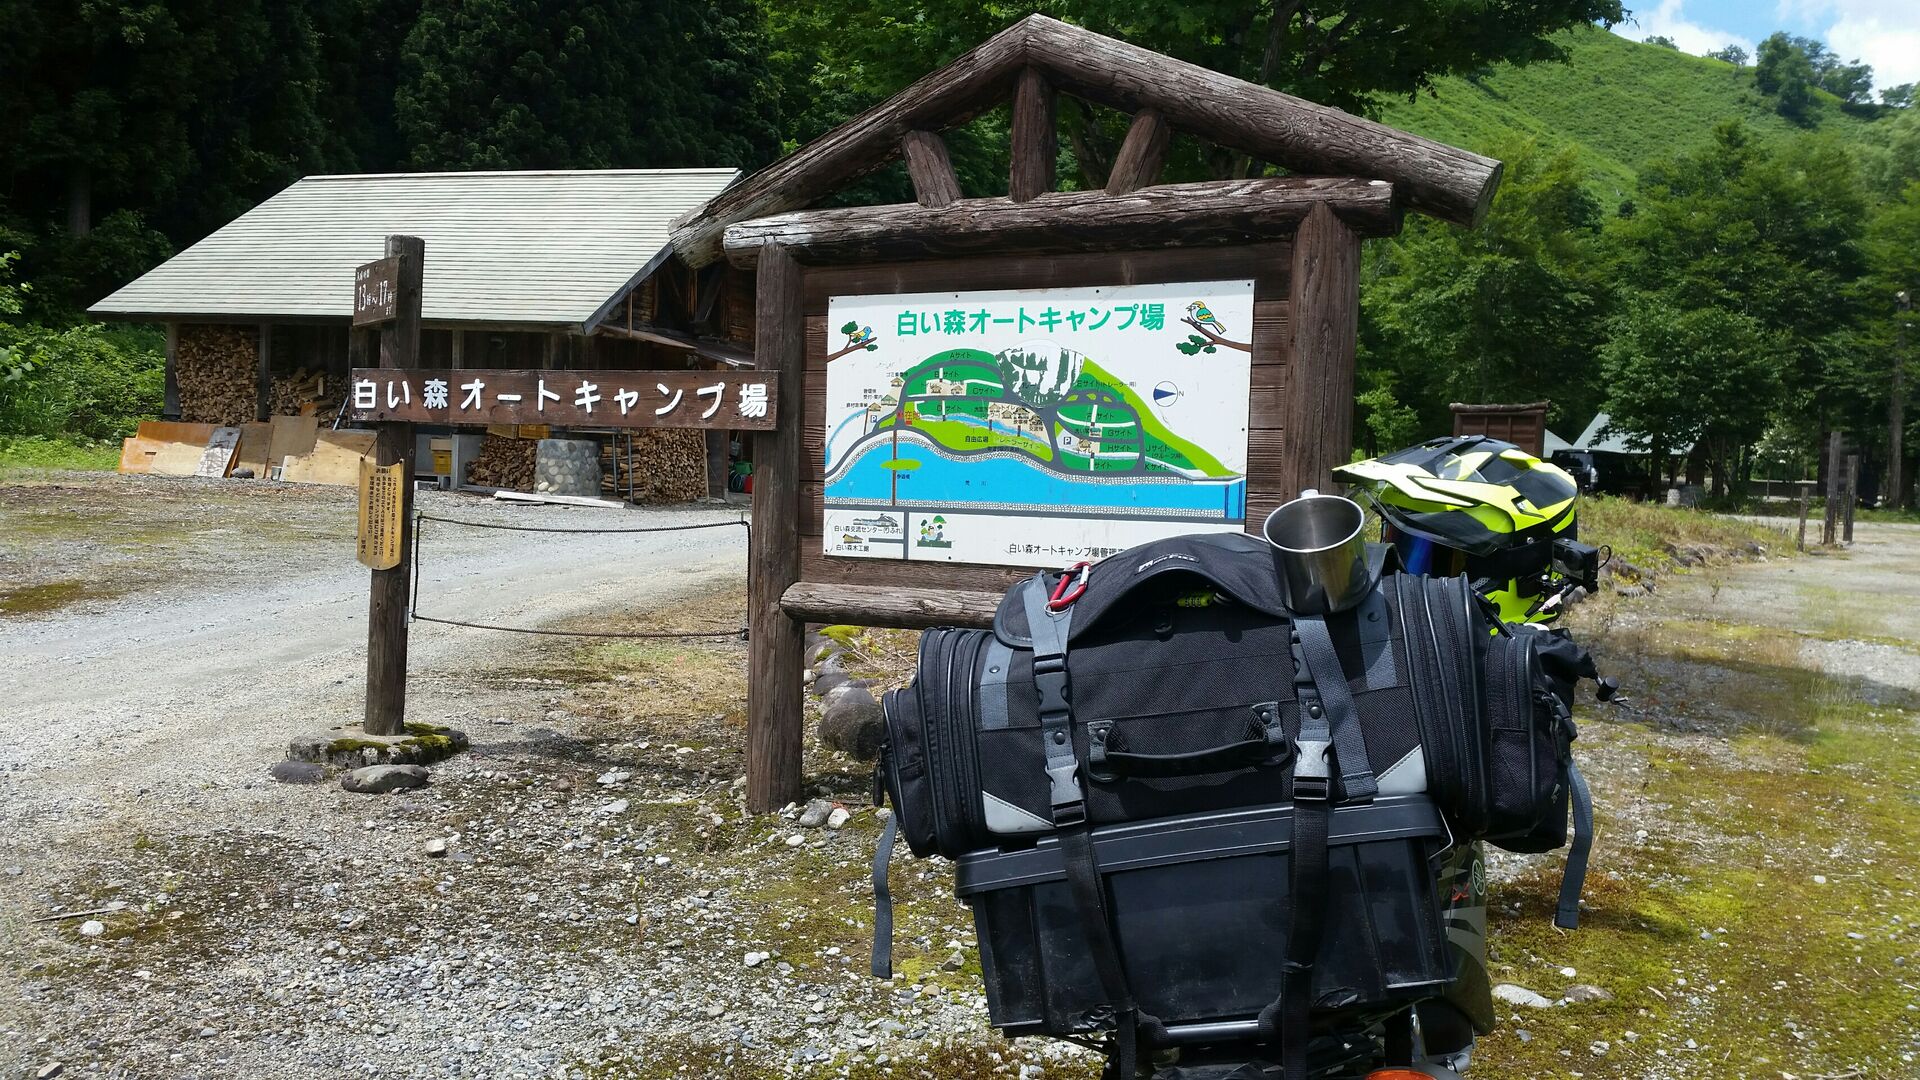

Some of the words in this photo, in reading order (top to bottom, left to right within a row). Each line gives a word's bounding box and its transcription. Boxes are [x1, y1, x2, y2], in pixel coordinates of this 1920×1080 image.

[897, 303, 1166, 337] 白い森オートキャンプ場
[353, 379, 769, 419] 白い森オートキャンプ場
[1009, 543, 1125, 558] 白い森オートキャンプ場管理
